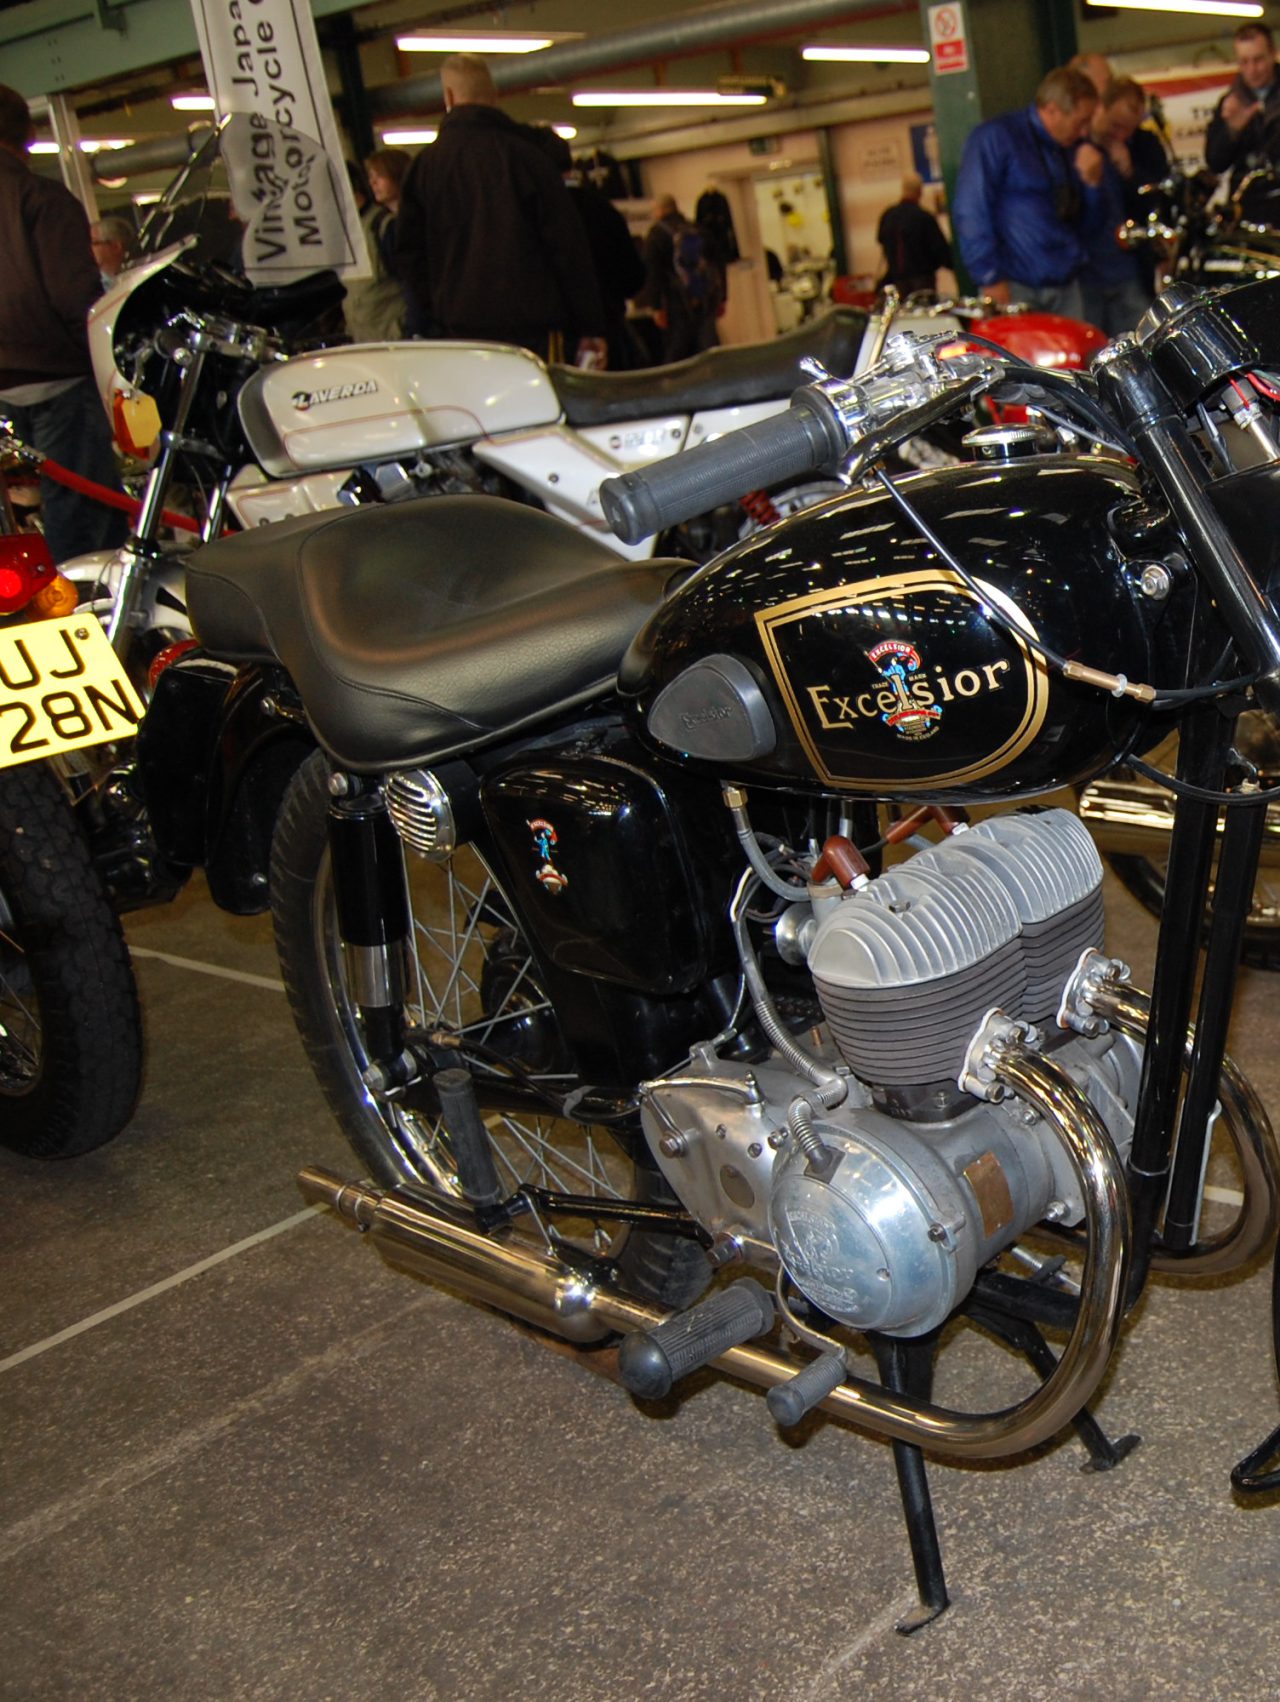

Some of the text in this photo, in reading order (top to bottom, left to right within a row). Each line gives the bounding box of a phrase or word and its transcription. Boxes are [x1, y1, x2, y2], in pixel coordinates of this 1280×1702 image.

[257, 21, 322, 245] Motorcycle
[292, 380, 378, 409] LAVERDA
[0, 629, 86, 690] UJ
[871, 642, 911, 660] EXCELSIOR
[0, 679, 140, 754] 28N
[806, 659, 1011, 730] Excelsior
